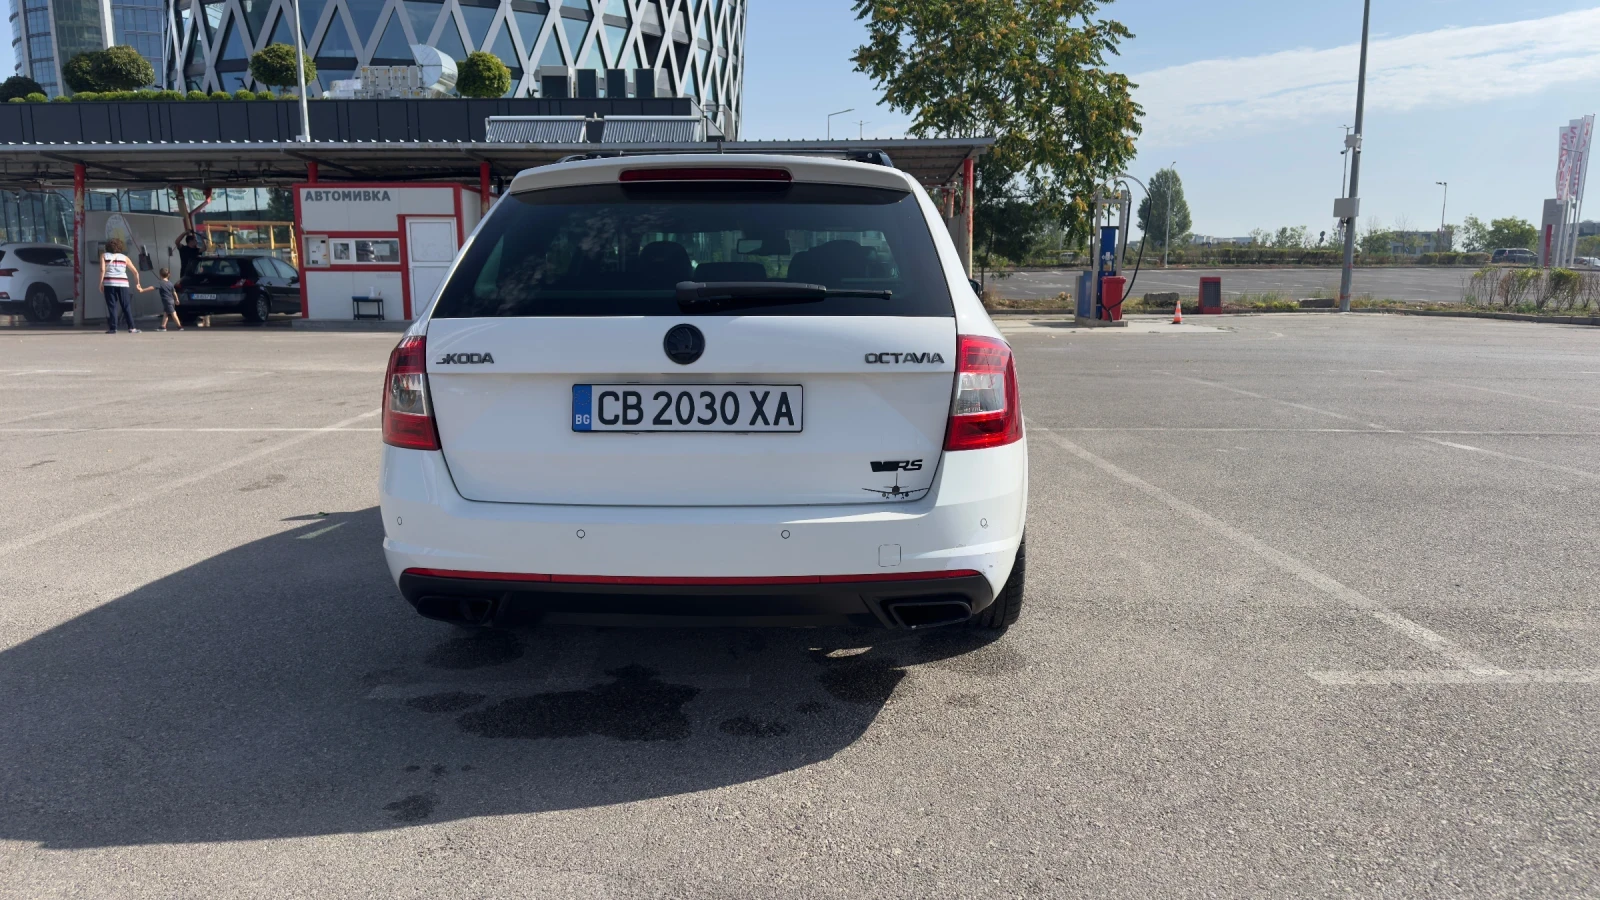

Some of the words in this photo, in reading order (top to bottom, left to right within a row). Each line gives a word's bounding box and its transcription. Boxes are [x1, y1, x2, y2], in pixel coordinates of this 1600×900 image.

[304, 190, 391, 202] АВТОМИВКА
[864, 352, 945, 364] OCTAVIA
[597, 390, 644, 426] CB
[652, 390, 740, 426] 2030
[748, 390, 795, 426] XA
[575, 414, 590, 425] BG
